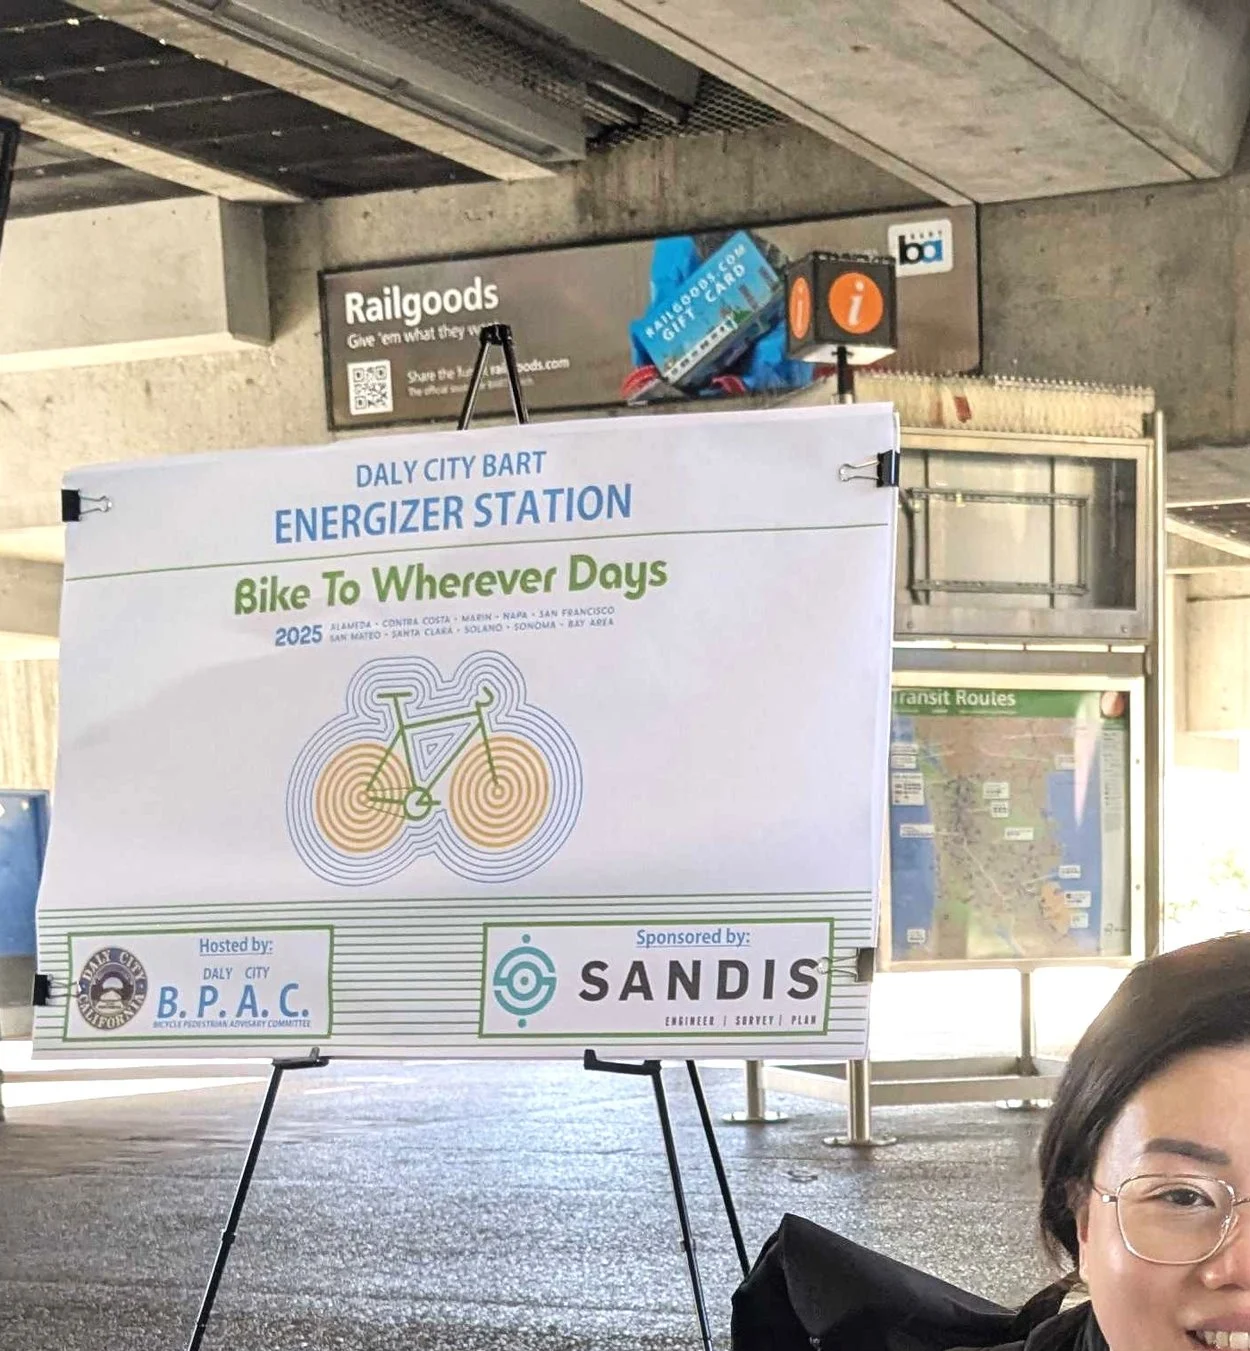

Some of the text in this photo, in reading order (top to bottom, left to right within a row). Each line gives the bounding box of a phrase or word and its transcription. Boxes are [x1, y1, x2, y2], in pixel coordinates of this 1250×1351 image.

[345, 276, 499, 326] Railgoods
[645, 244, 746, 338] RAILGOODS.COM
[662, 264, 745, 340] GIFT CARD
[347, 332, 375, 349] Give
[403, 326, 436, 344] what
[438, 323, 465, 340] they
[407, 370, 436, 384] Share
[438, 367, 455, 380] the
[490, 358, 570, 375] railoods.com
[356, 450, 547, 489] DALY CITY BART
[275, 483, 632, 544] ENERGIZER STATION
[234, 554, 668, 615] Bike To Wherever Days
[330, 605, 615, 631] ALAMEDA CONTRA COSTA MARIN NAPA SAN FRANCISCO
[330, 617, 614, 643] SAN MATEO SANTA CLARA SOLANO SONOMA BAY AREA
[275, 624, 322, 646] 2025
[955, 689, 1016, 707] Routes
[200, 936, 273, 955] Hosted by:
[636, 928, 750, 948] Sponsored by:
[83, 950, 146, 980] DALY CITY
[203, 966, 270, 980] DALY CITY
[579, 958, 819, 1001] SANDIS
[79, 994, 145, 1029] CALIFORNIA
[153, 1020, 182, 1029] BICYCLE
[267, 1019, 311, 1028] COMMITTEE
[665, 1014, 817, 1026] ENGINEER SURVEY PLAN
